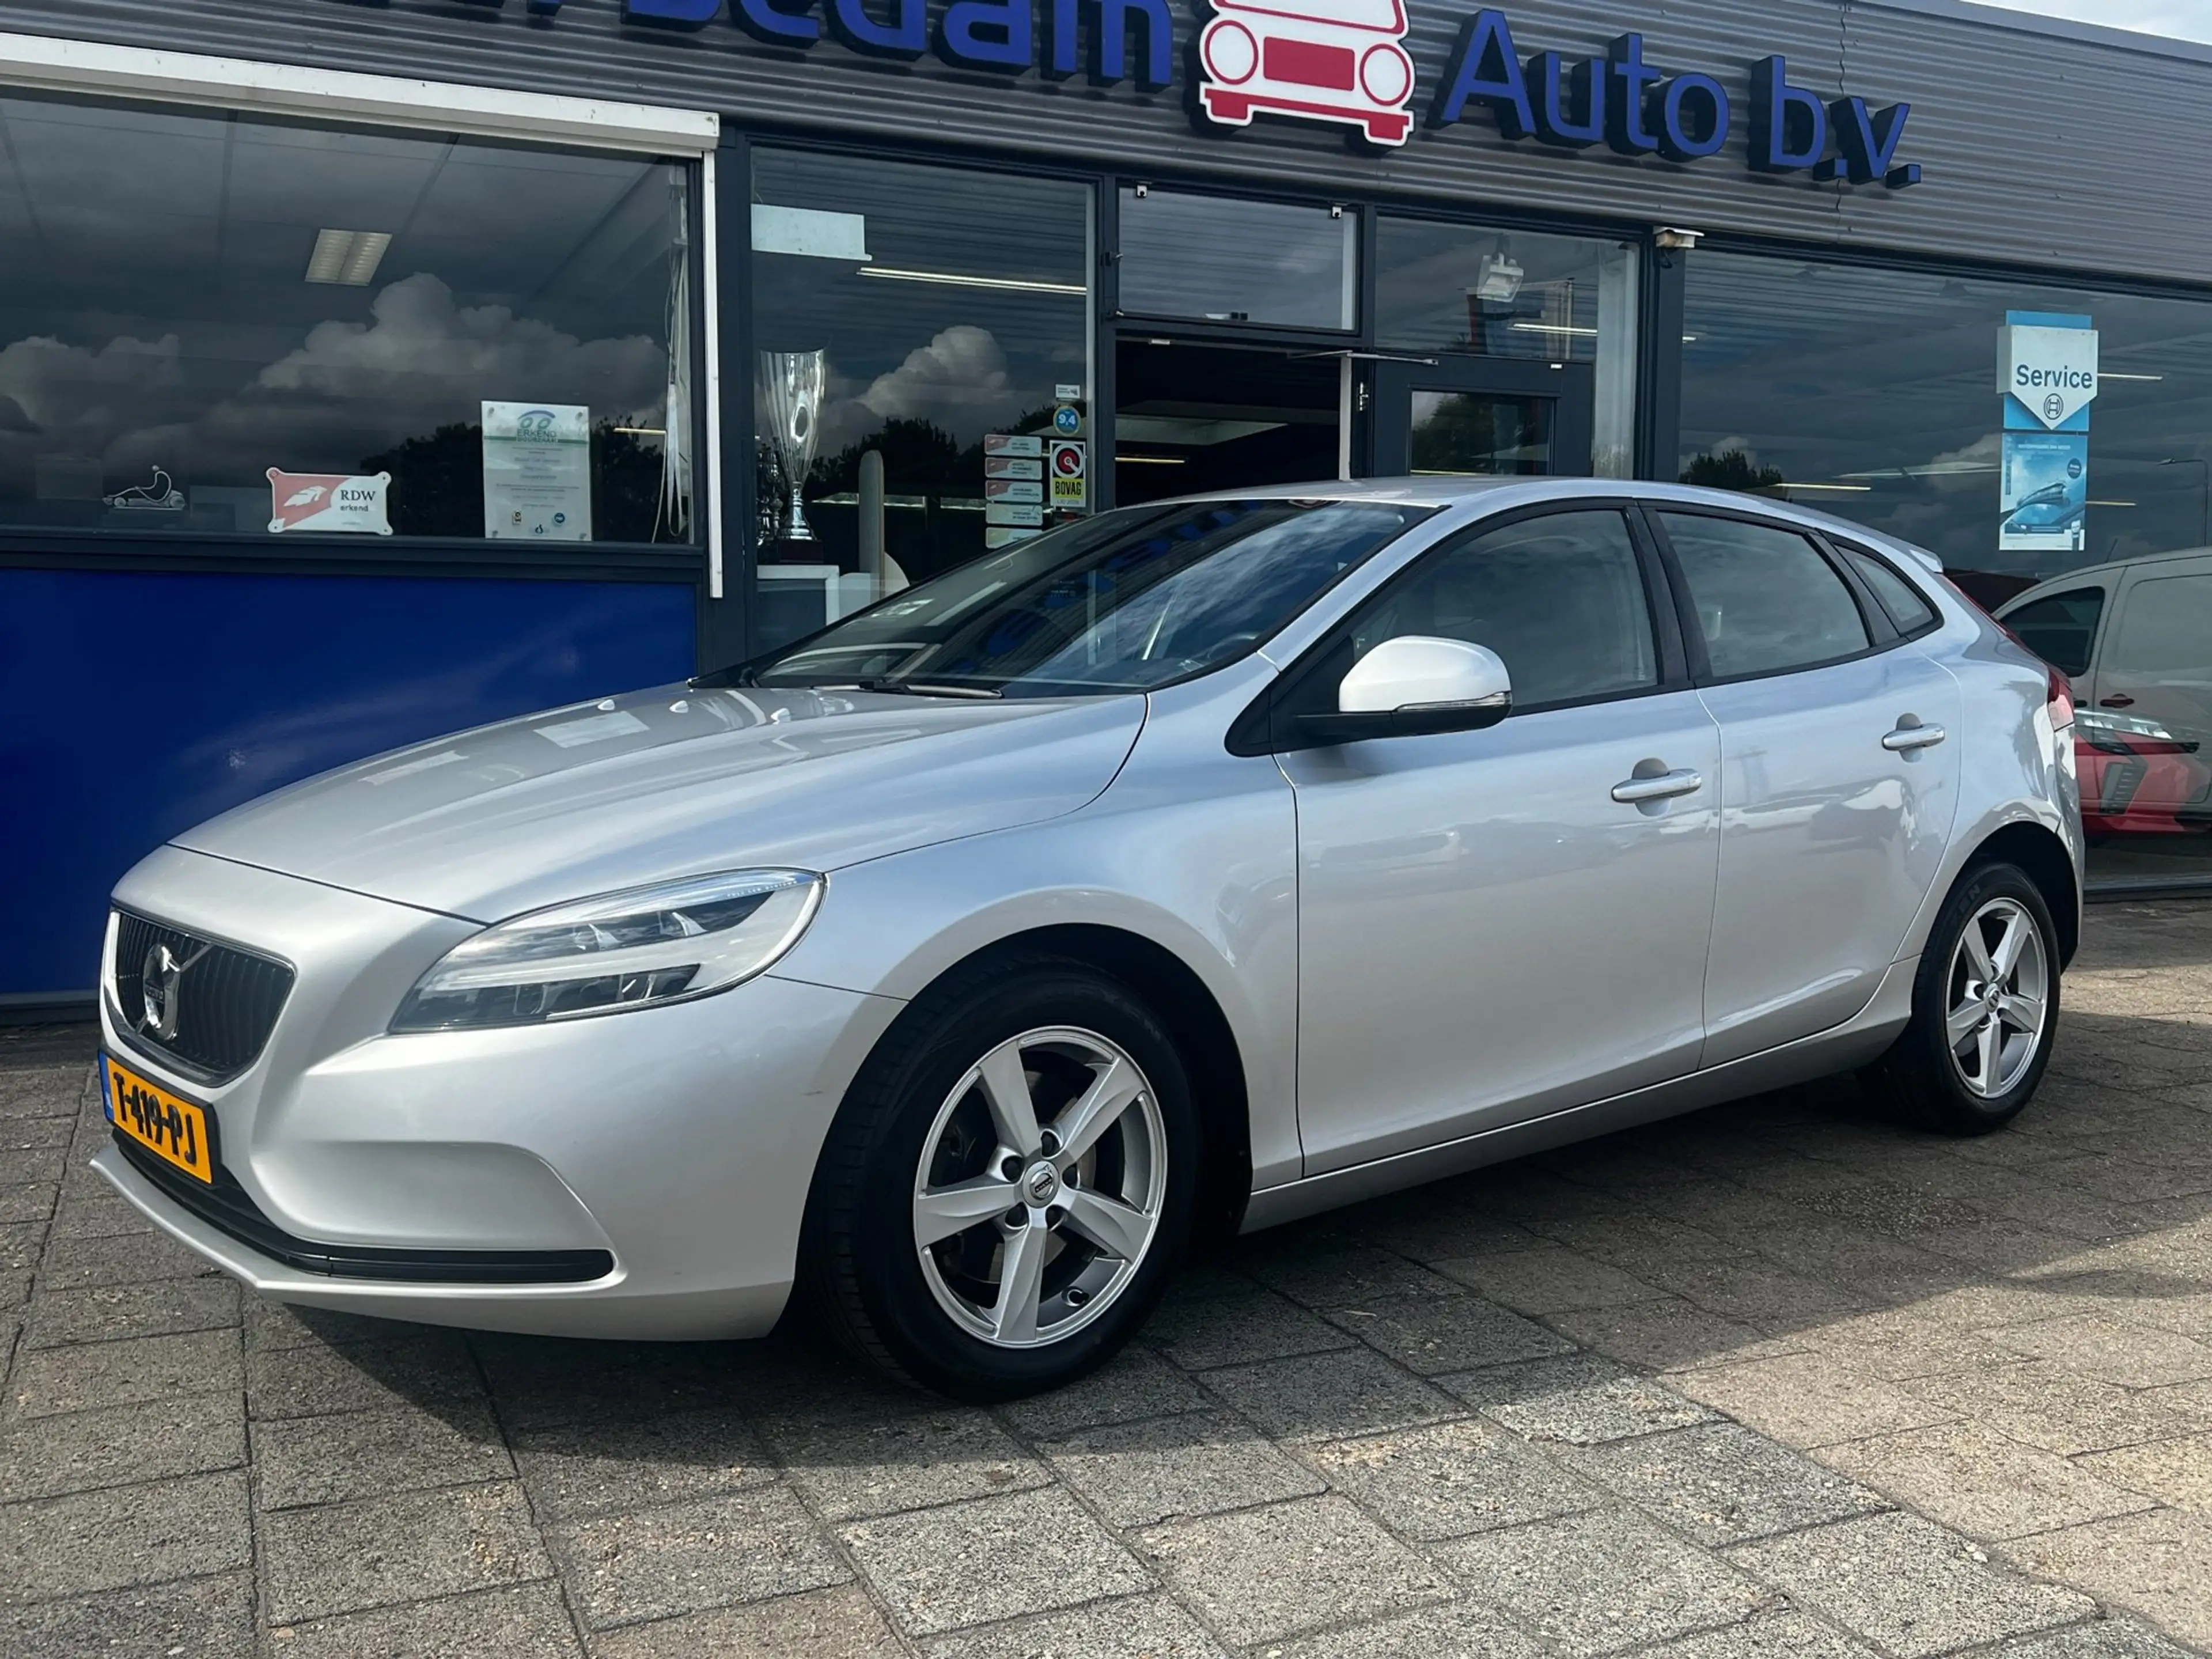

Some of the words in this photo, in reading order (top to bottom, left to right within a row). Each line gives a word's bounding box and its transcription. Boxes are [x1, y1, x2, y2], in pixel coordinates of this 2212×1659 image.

[1439, 8, 1730, 157] Auto
[1766, 55, 1922, 187] b.v.
[2016, 365, 2093, 389] Service
[1058, 414, 1076, 426] 9,4
[517, 429, 557, 438] ERKEND
[1055, 480, 1082, 496] BOVAG
[340, 490, 375, 501] RDW
[340, 503, 369, 512] erkend
[114, 1072, 197, 1166] T-419-PJ
